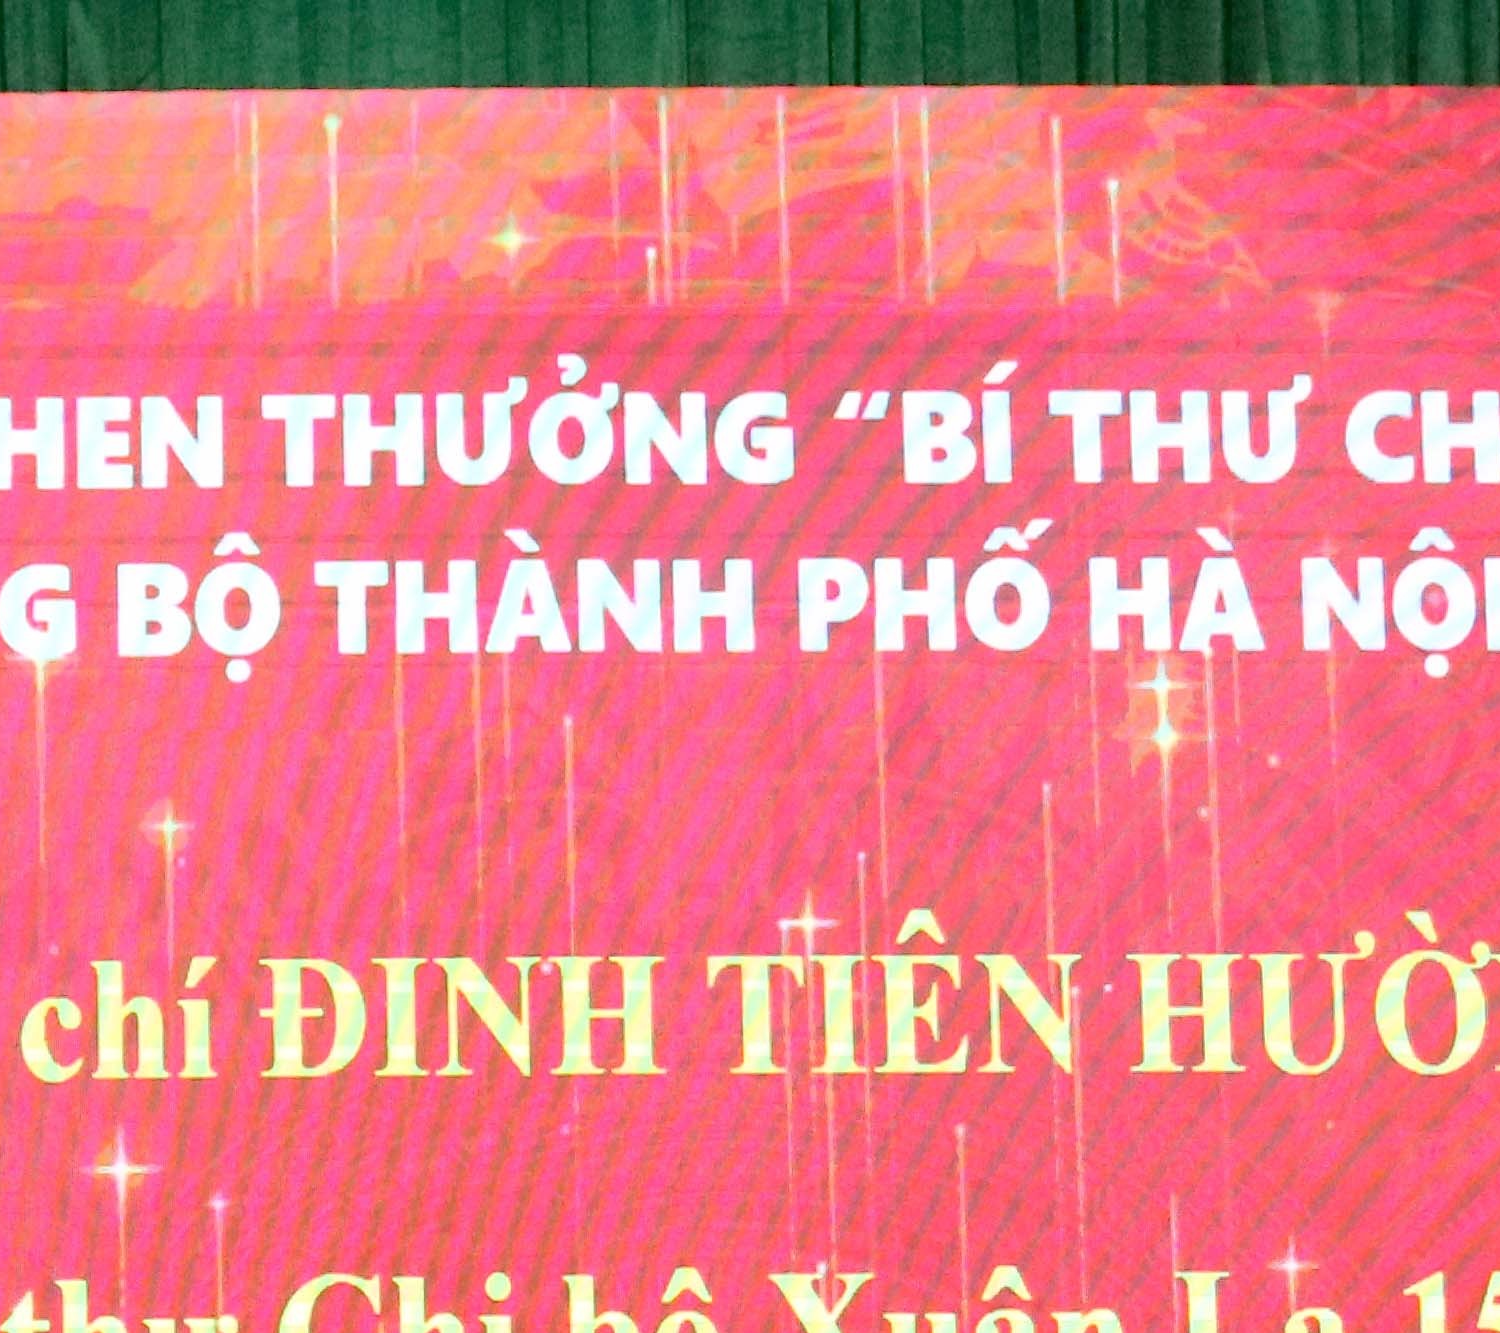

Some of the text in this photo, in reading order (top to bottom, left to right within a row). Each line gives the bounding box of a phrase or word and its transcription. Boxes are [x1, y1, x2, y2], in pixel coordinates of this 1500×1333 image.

[262, 355, 794, 486] THƯỞNG
[1049, 375, 1312, 483] THƯ
[118, 533, 280, 682] BỘ
[315, 530, 755, 654] THÀNH
[798, 519, 1050, 651] PHỐ
[1089, 528, 1264, 652] HÀ
[21, 957, 215, 1082] chí
[260, 956, 659, 1077] ĐINH
[708, 908, 1078, 1074] TIÊN
